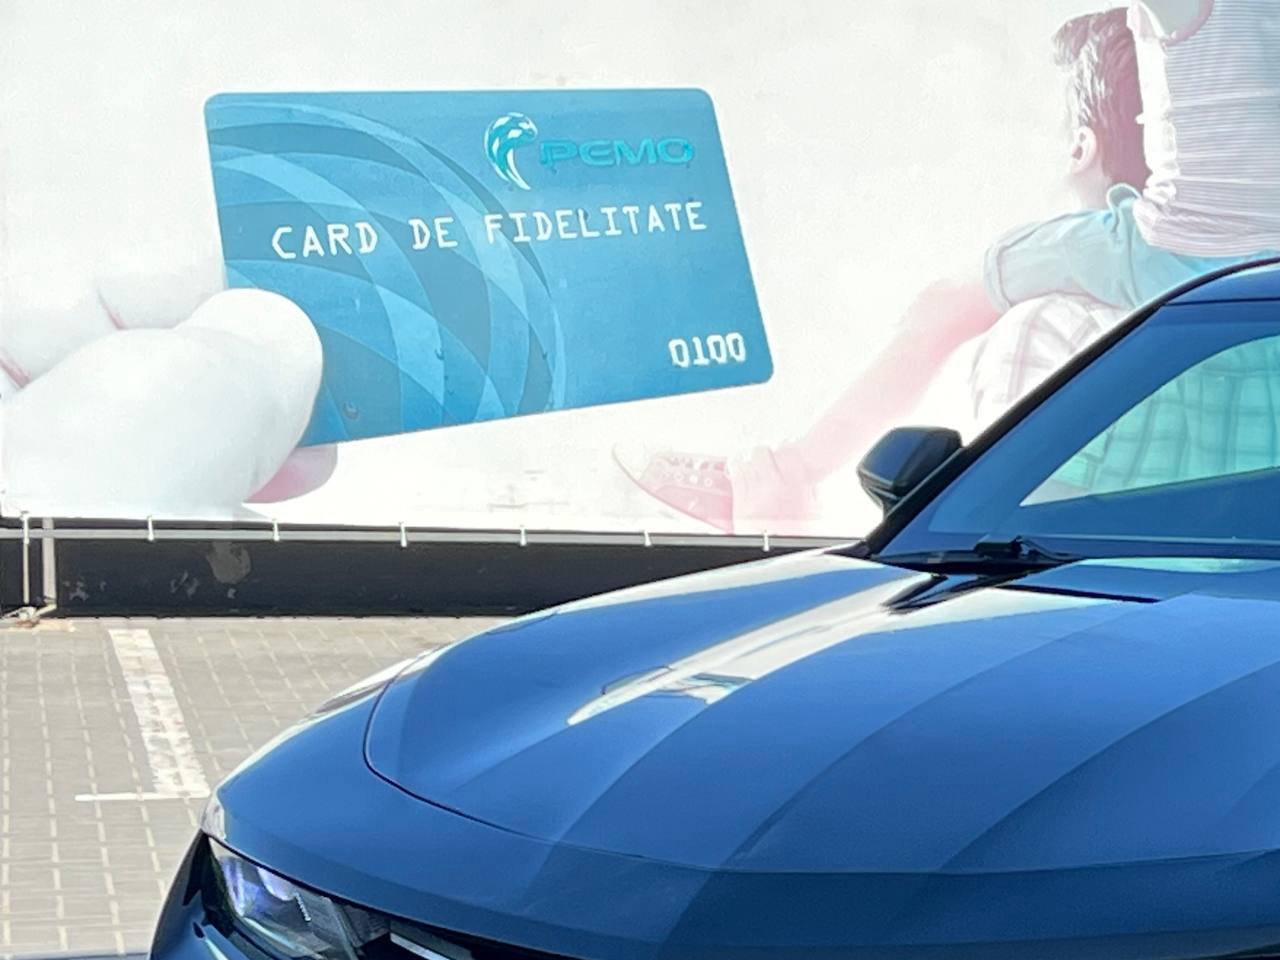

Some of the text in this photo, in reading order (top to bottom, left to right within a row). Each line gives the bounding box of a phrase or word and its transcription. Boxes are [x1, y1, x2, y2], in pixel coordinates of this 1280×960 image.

[271, 202, 706, 260] CARD DE FIDELITATE
[669, 333, 746, 368] 0100
